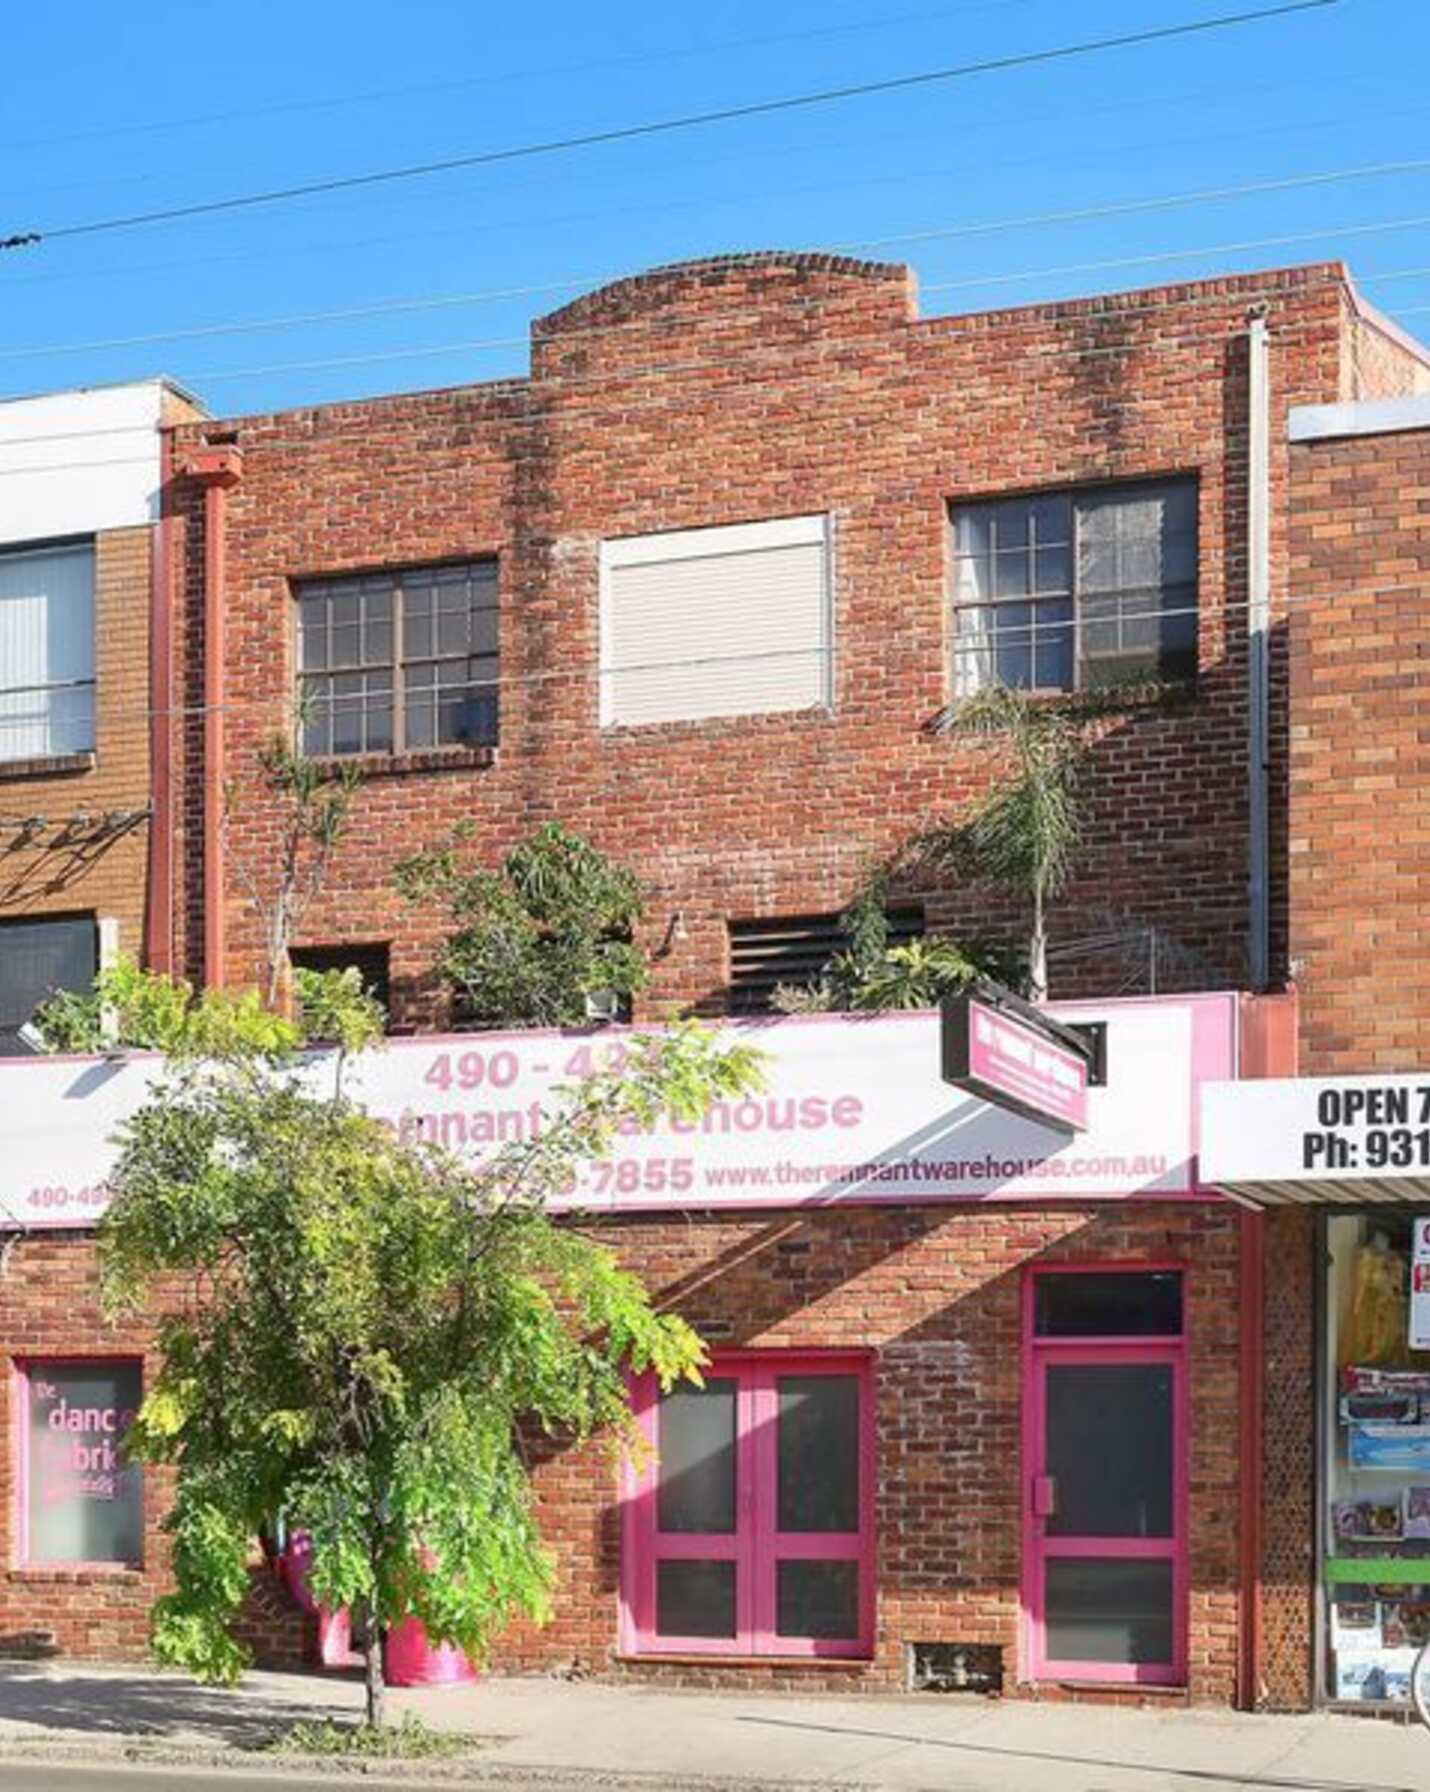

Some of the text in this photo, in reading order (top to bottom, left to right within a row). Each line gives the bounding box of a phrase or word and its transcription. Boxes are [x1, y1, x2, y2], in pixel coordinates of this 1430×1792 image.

[424, 1052, 519, 1091] 490
[1317, 1086, 1430, 1127] OPEN 7
[1303, 1129, 1430, 1169] Ph: 931
